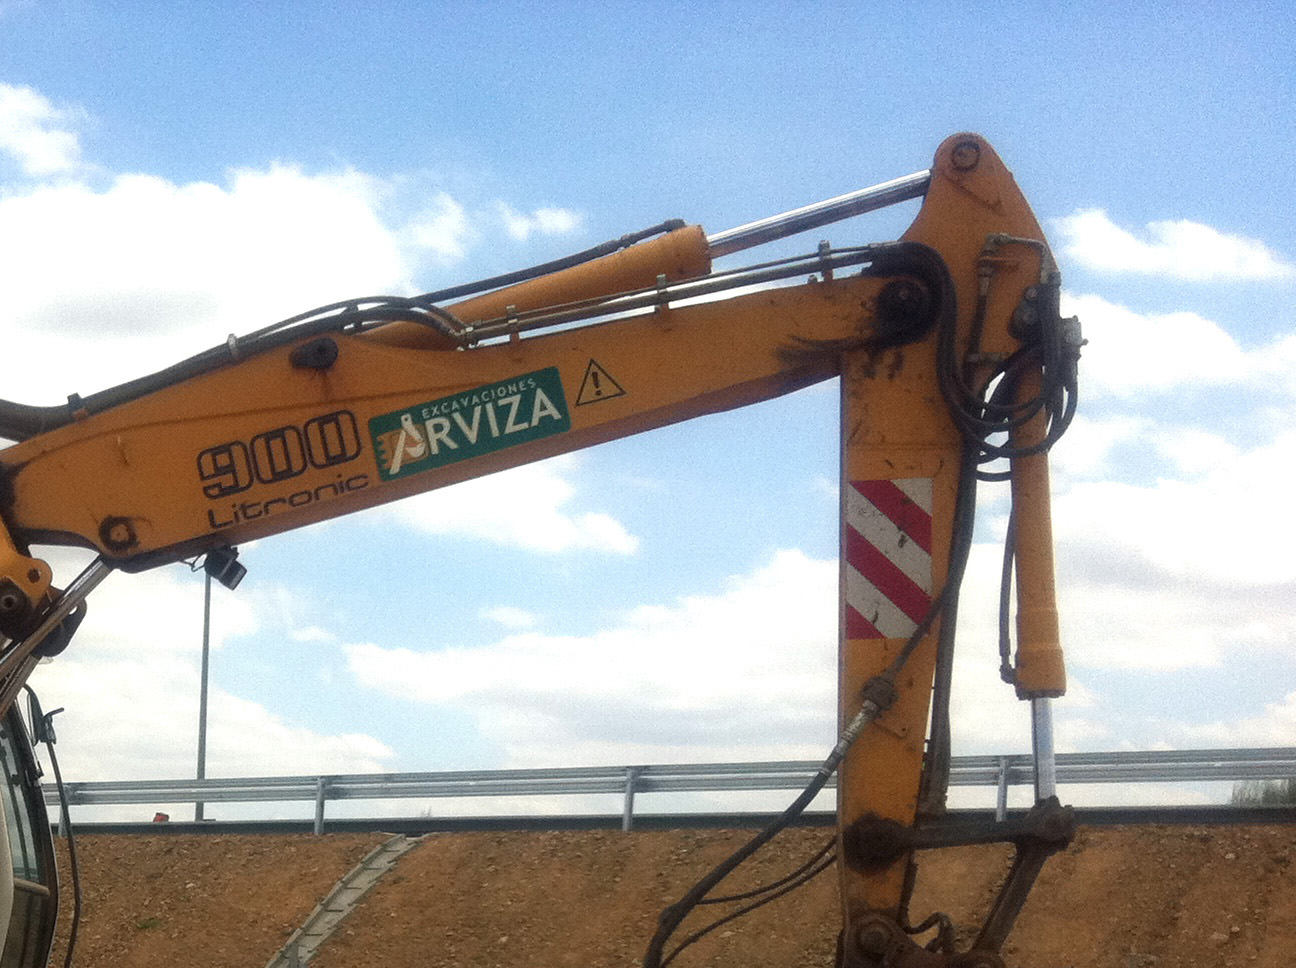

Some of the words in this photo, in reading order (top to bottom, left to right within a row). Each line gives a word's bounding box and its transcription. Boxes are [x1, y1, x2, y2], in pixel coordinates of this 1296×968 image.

[389, 387, 562, 475] ARVIZA
[421, 377, 537, 419] EXCAVACIONES
[196, 409, 363, 500] 900
[208, 473, 370, 529] Litronic
